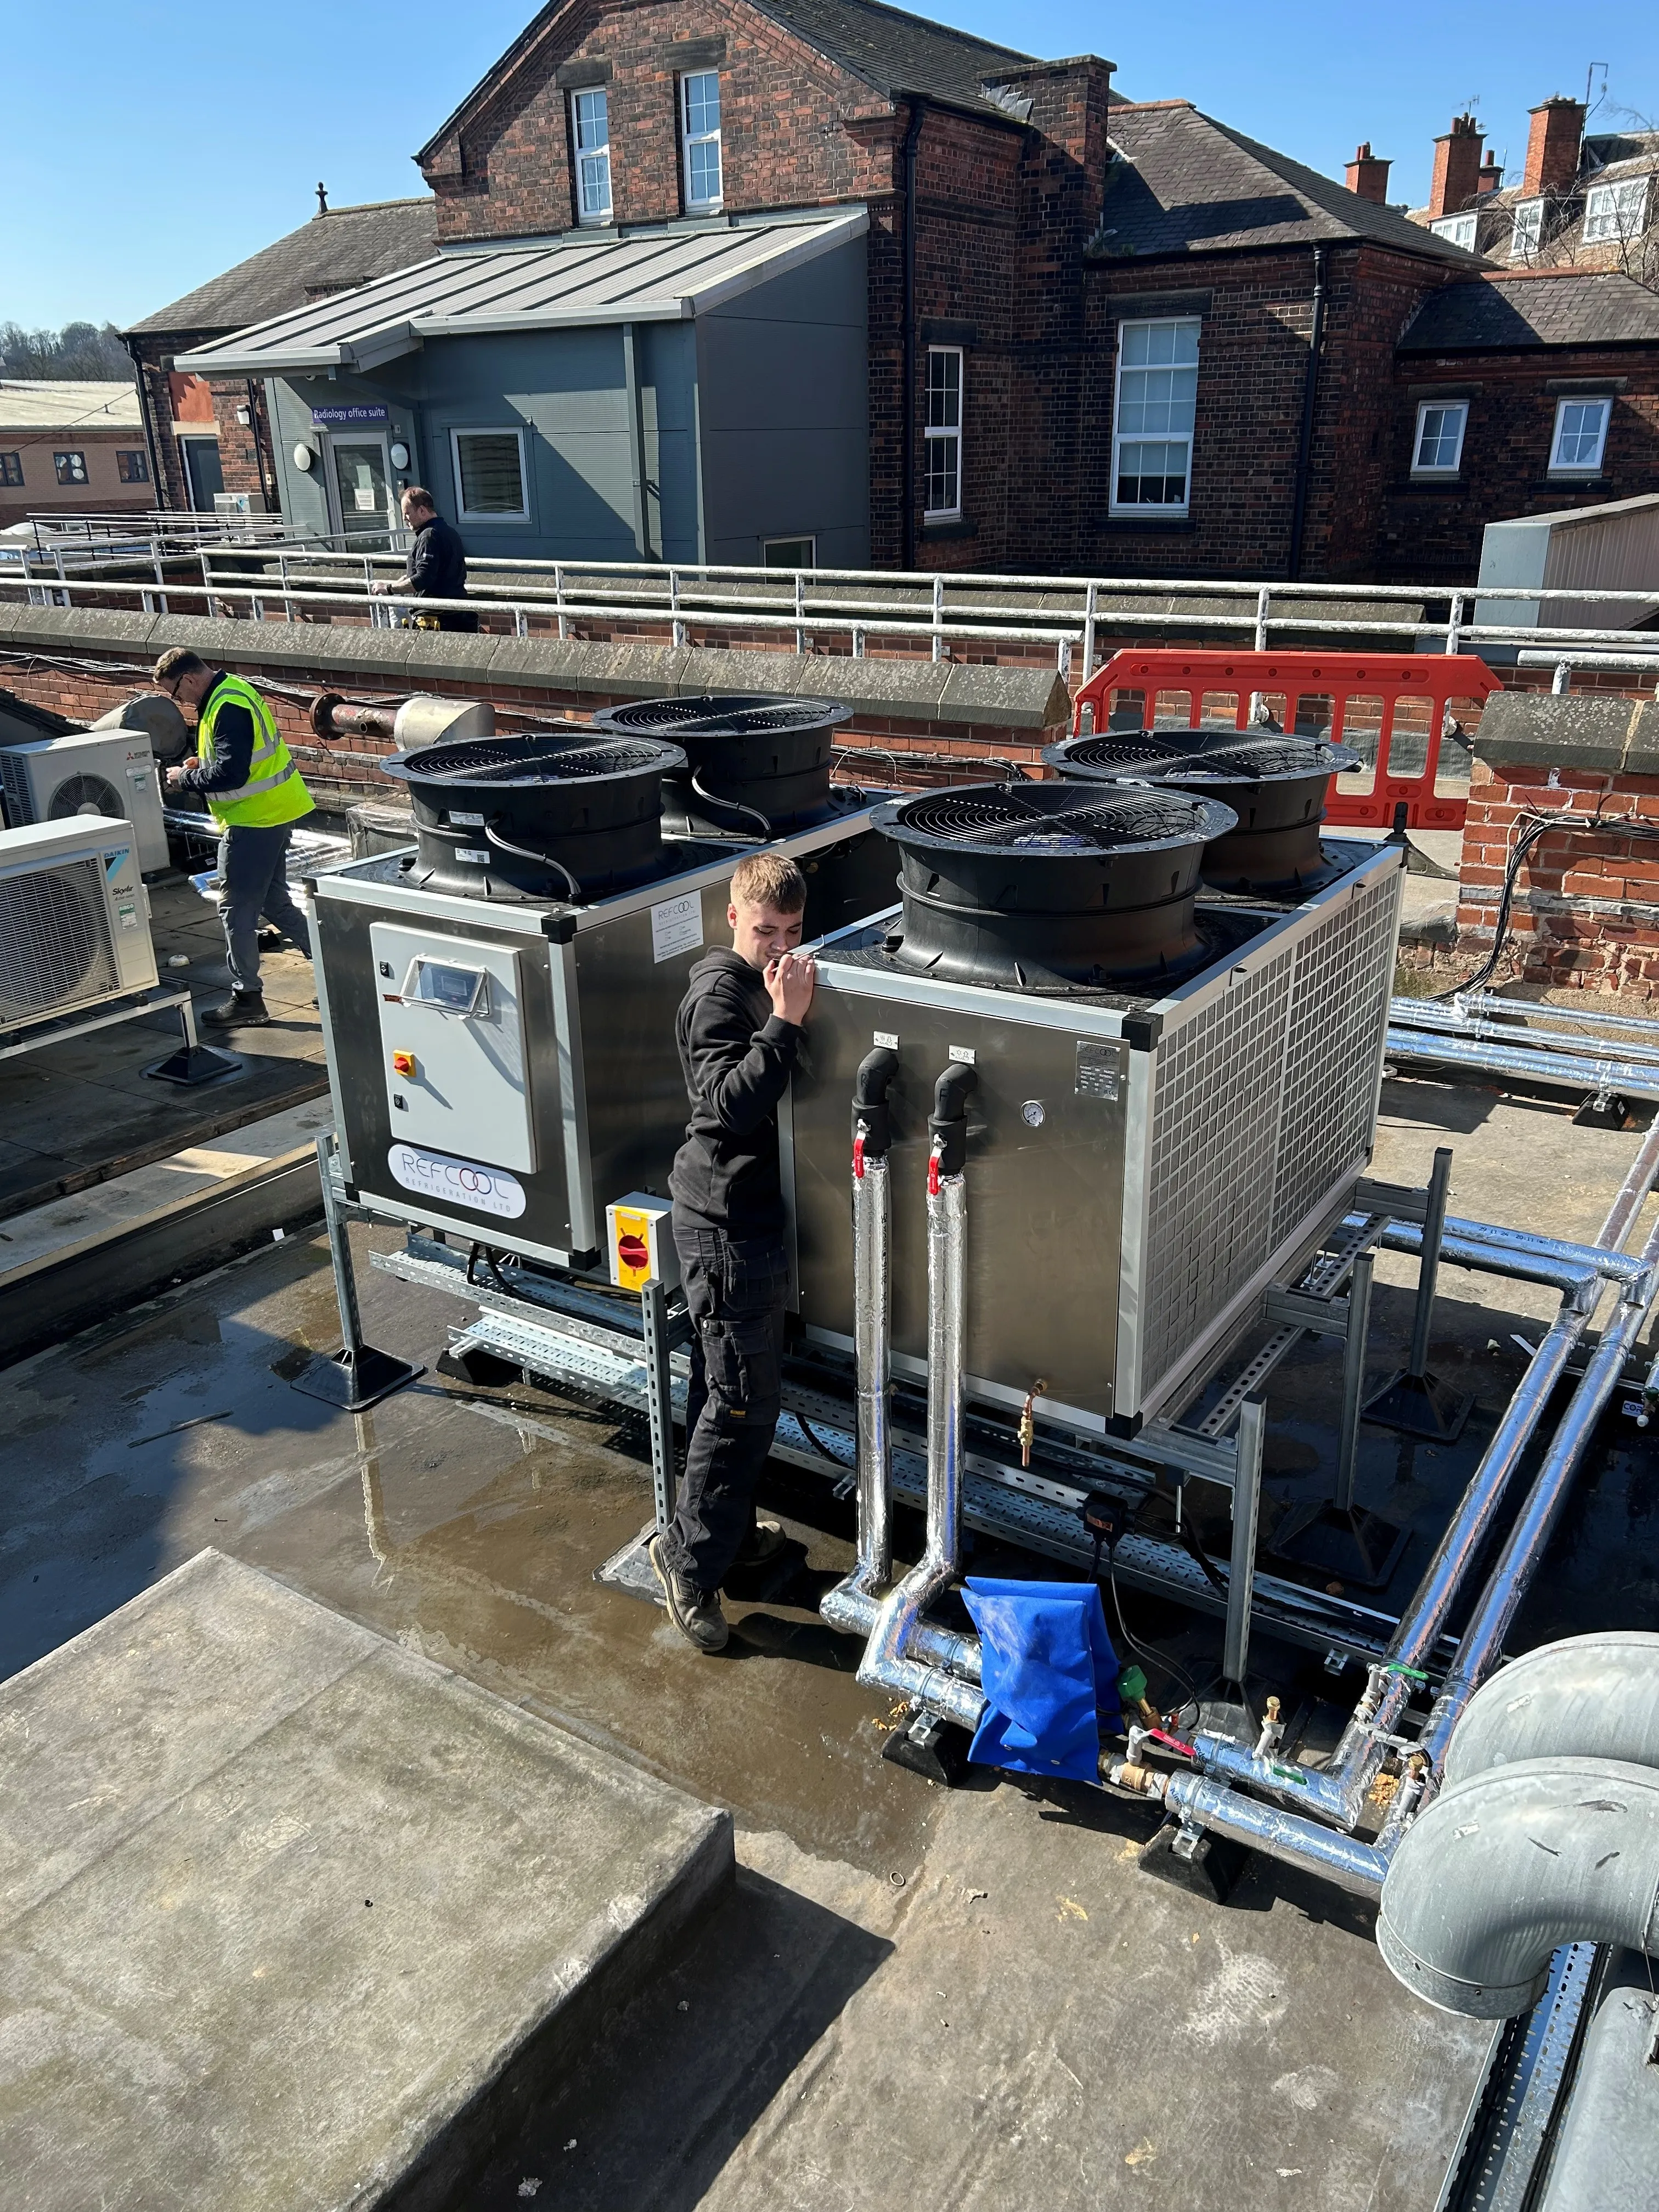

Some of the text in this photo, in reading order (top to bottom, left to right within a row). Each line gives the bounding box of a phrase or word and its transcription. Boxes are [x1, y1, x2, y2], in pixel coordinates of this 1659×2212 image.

[313, 407, 386, 421] Radiology office suite
[104, 848, 129, 859] DAIKIN
[658, 900, 695, 920] REFCOOL
[939, 1088, 950, 1102] F
[402, 1153, 509, 1199] REFCOOL
[405, 1176, 511, 1212] REFRIGERATION LTD
